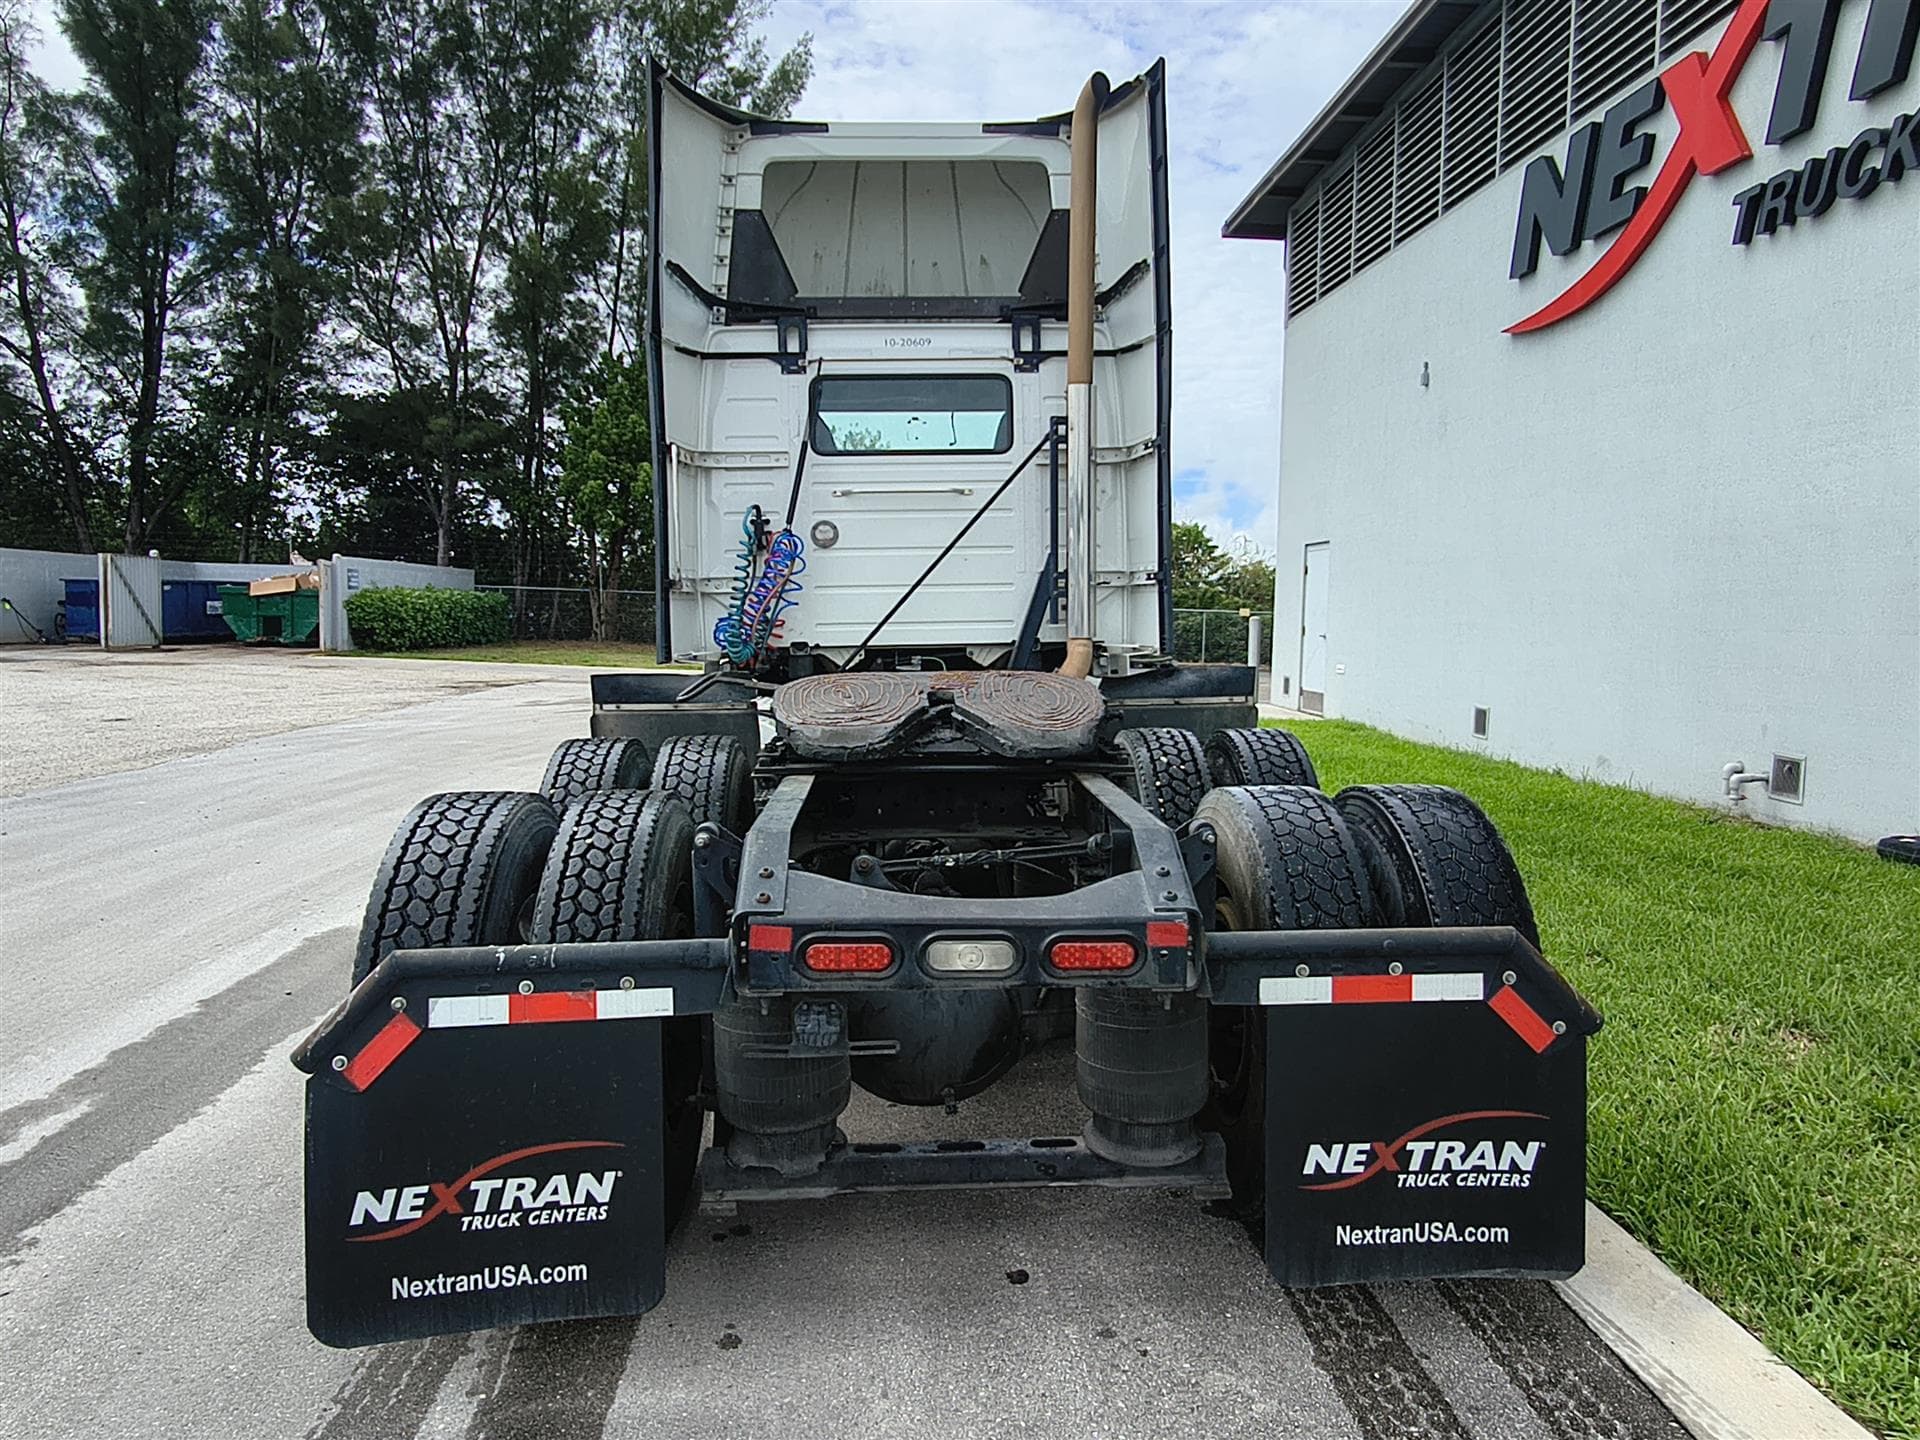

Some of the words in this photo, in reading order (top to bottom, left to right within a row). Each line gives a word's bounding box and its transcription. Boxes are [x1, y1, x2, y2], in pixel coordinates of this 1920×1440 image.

[1508, 0, 1920, 280] NEXT
[1732, 106, 1920, 245] TRUCK
[884, 337, 932, 348] 10-20609
[1302, 1141, 1540, 1175] NEXTRAN
[1397, 1173, 1451, 1188] TRUCK
[1456, 1173, 1531, 1187] CENTERS
[350, 1171, 616, 1225] NEXTRAN
[461, 1211, 522, 1232] TRUCK
[528, 1205, 608, 1225] CENTERS
[1336, 1222, 1509, 1245] NextranUSA.com
[391, 1263, 587, 1299] NextranUSA.com
